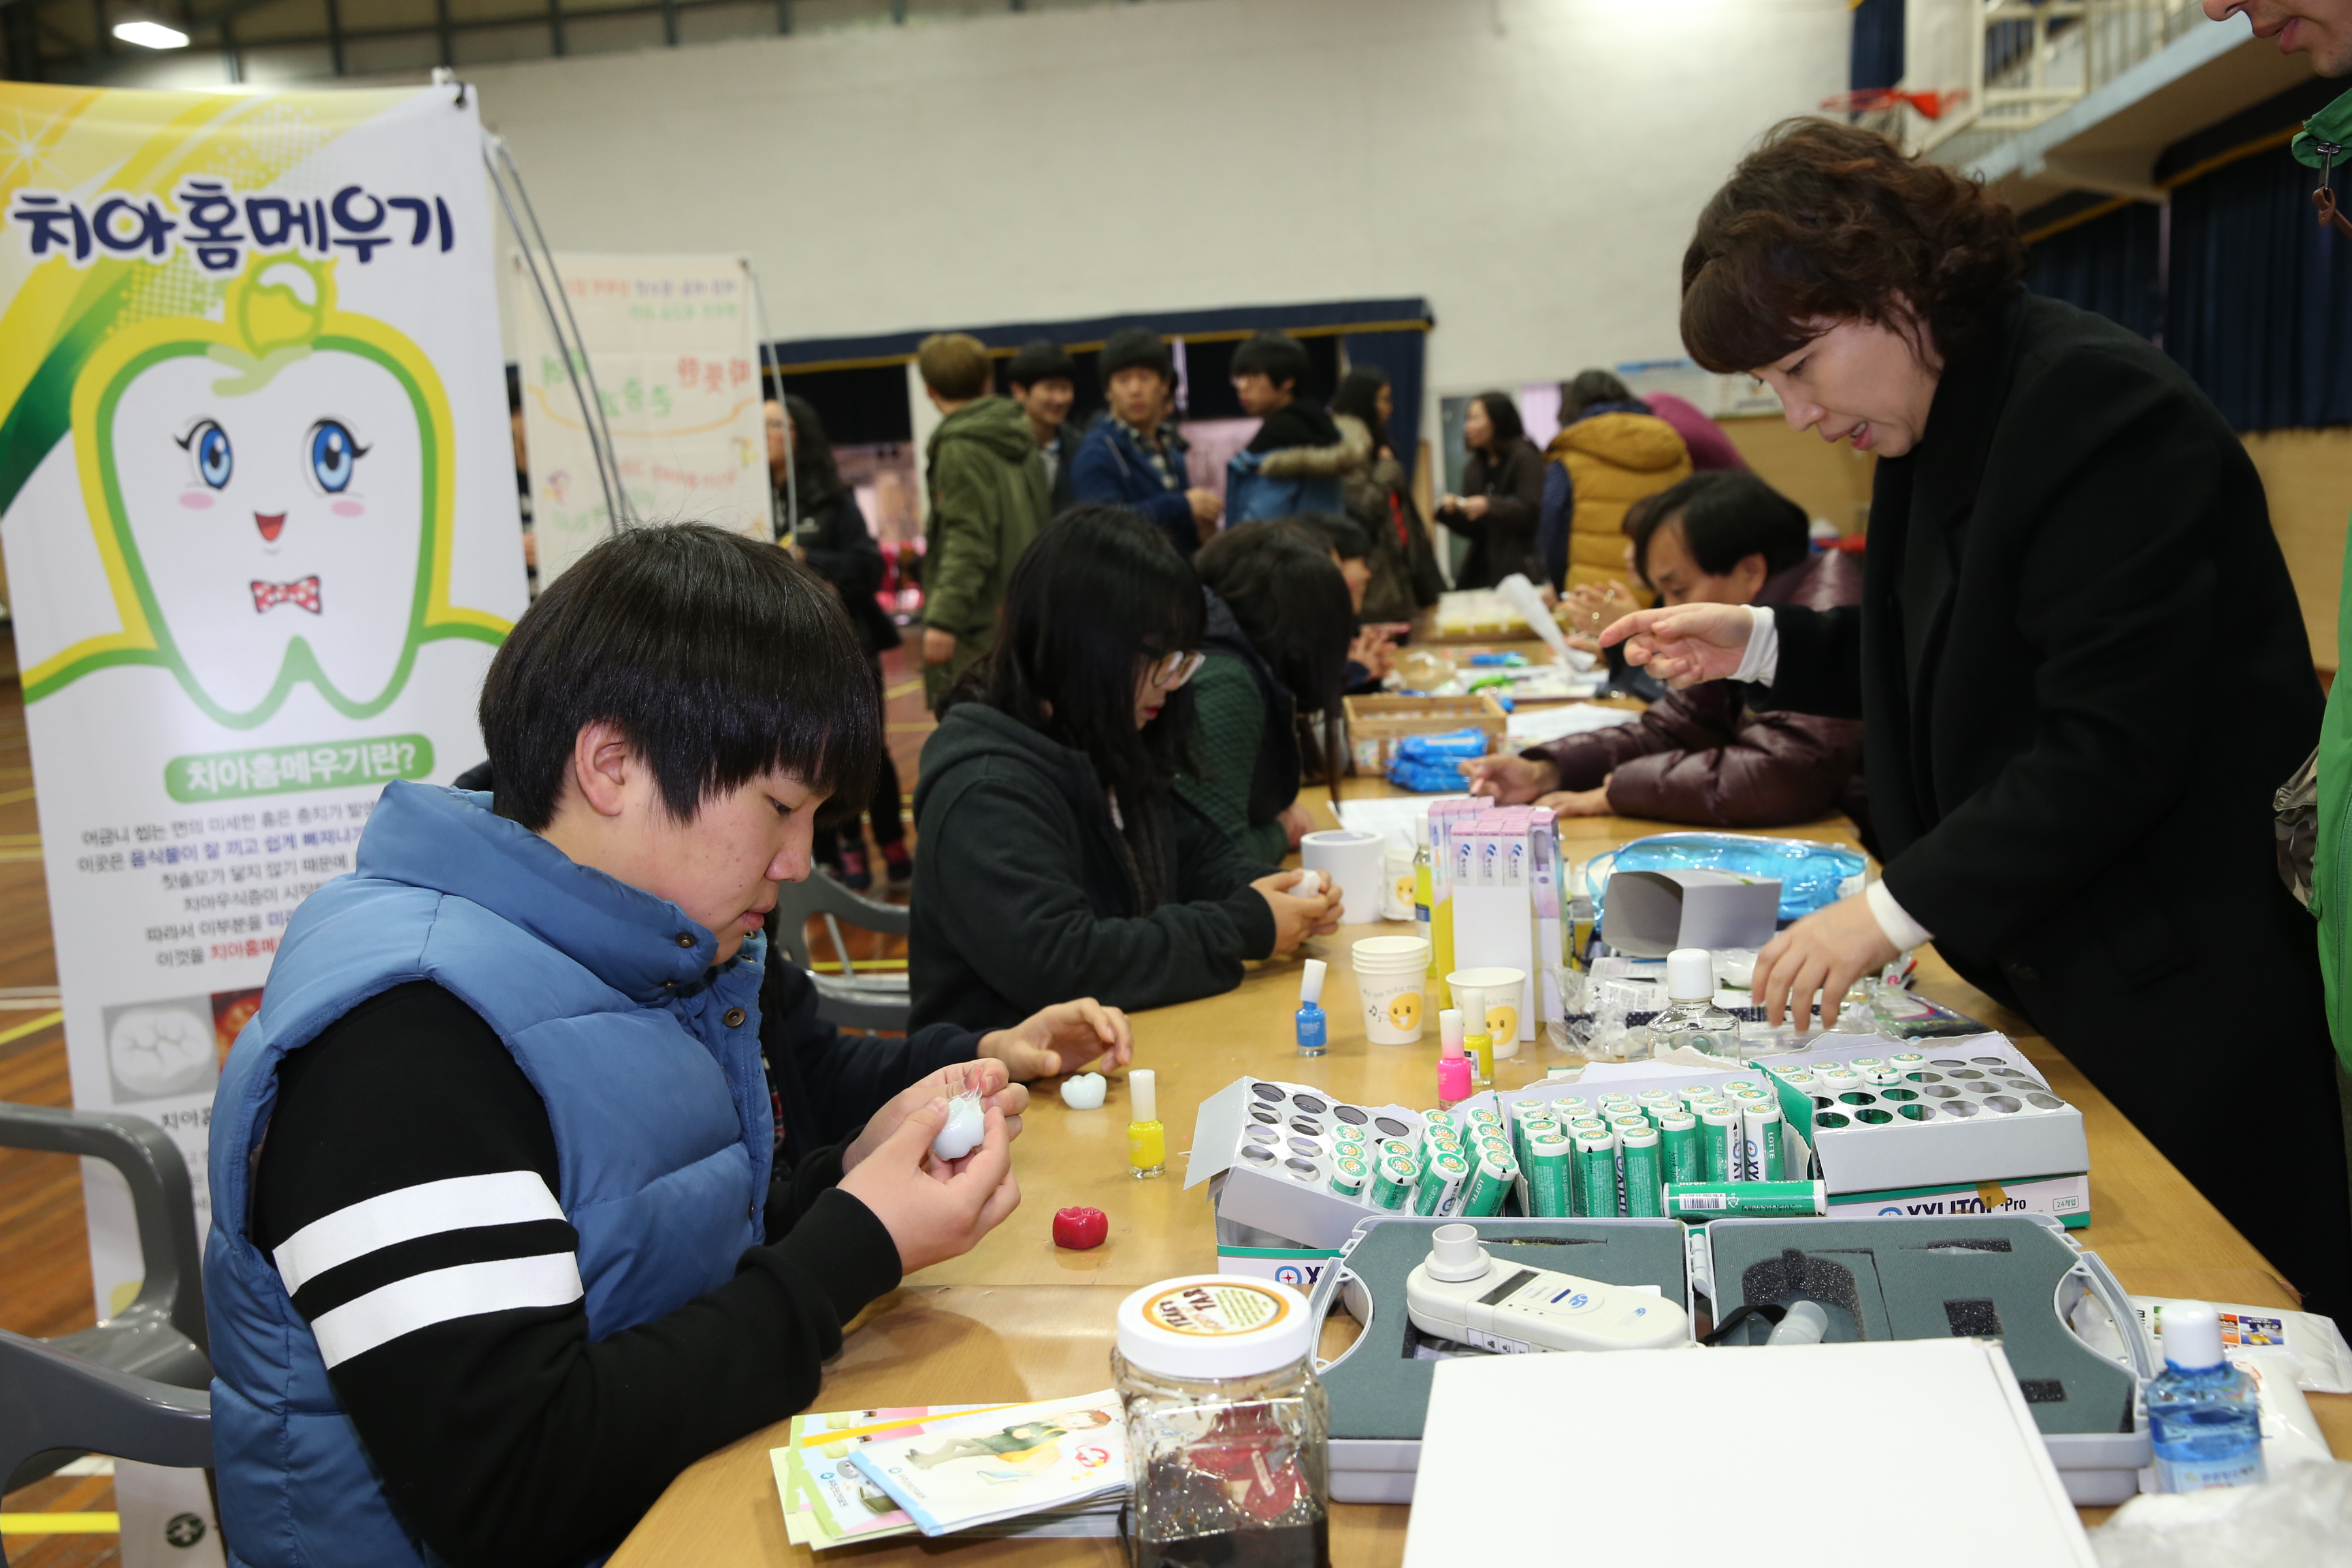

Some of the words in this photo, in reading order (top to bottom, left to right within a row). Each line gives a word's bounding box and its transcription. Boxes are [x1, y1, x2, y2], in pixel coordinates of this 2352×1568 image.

[14, 180, 455, 270] 치아홈메우기
[186, 742, 416, 794] 치아홈메우기란?
[1767, 1132, 1776, 1159] LOTTE
[1471, 1179, 1484, 1204] LOTTE
[2057, 1198, 2076, 1207] 24개입
